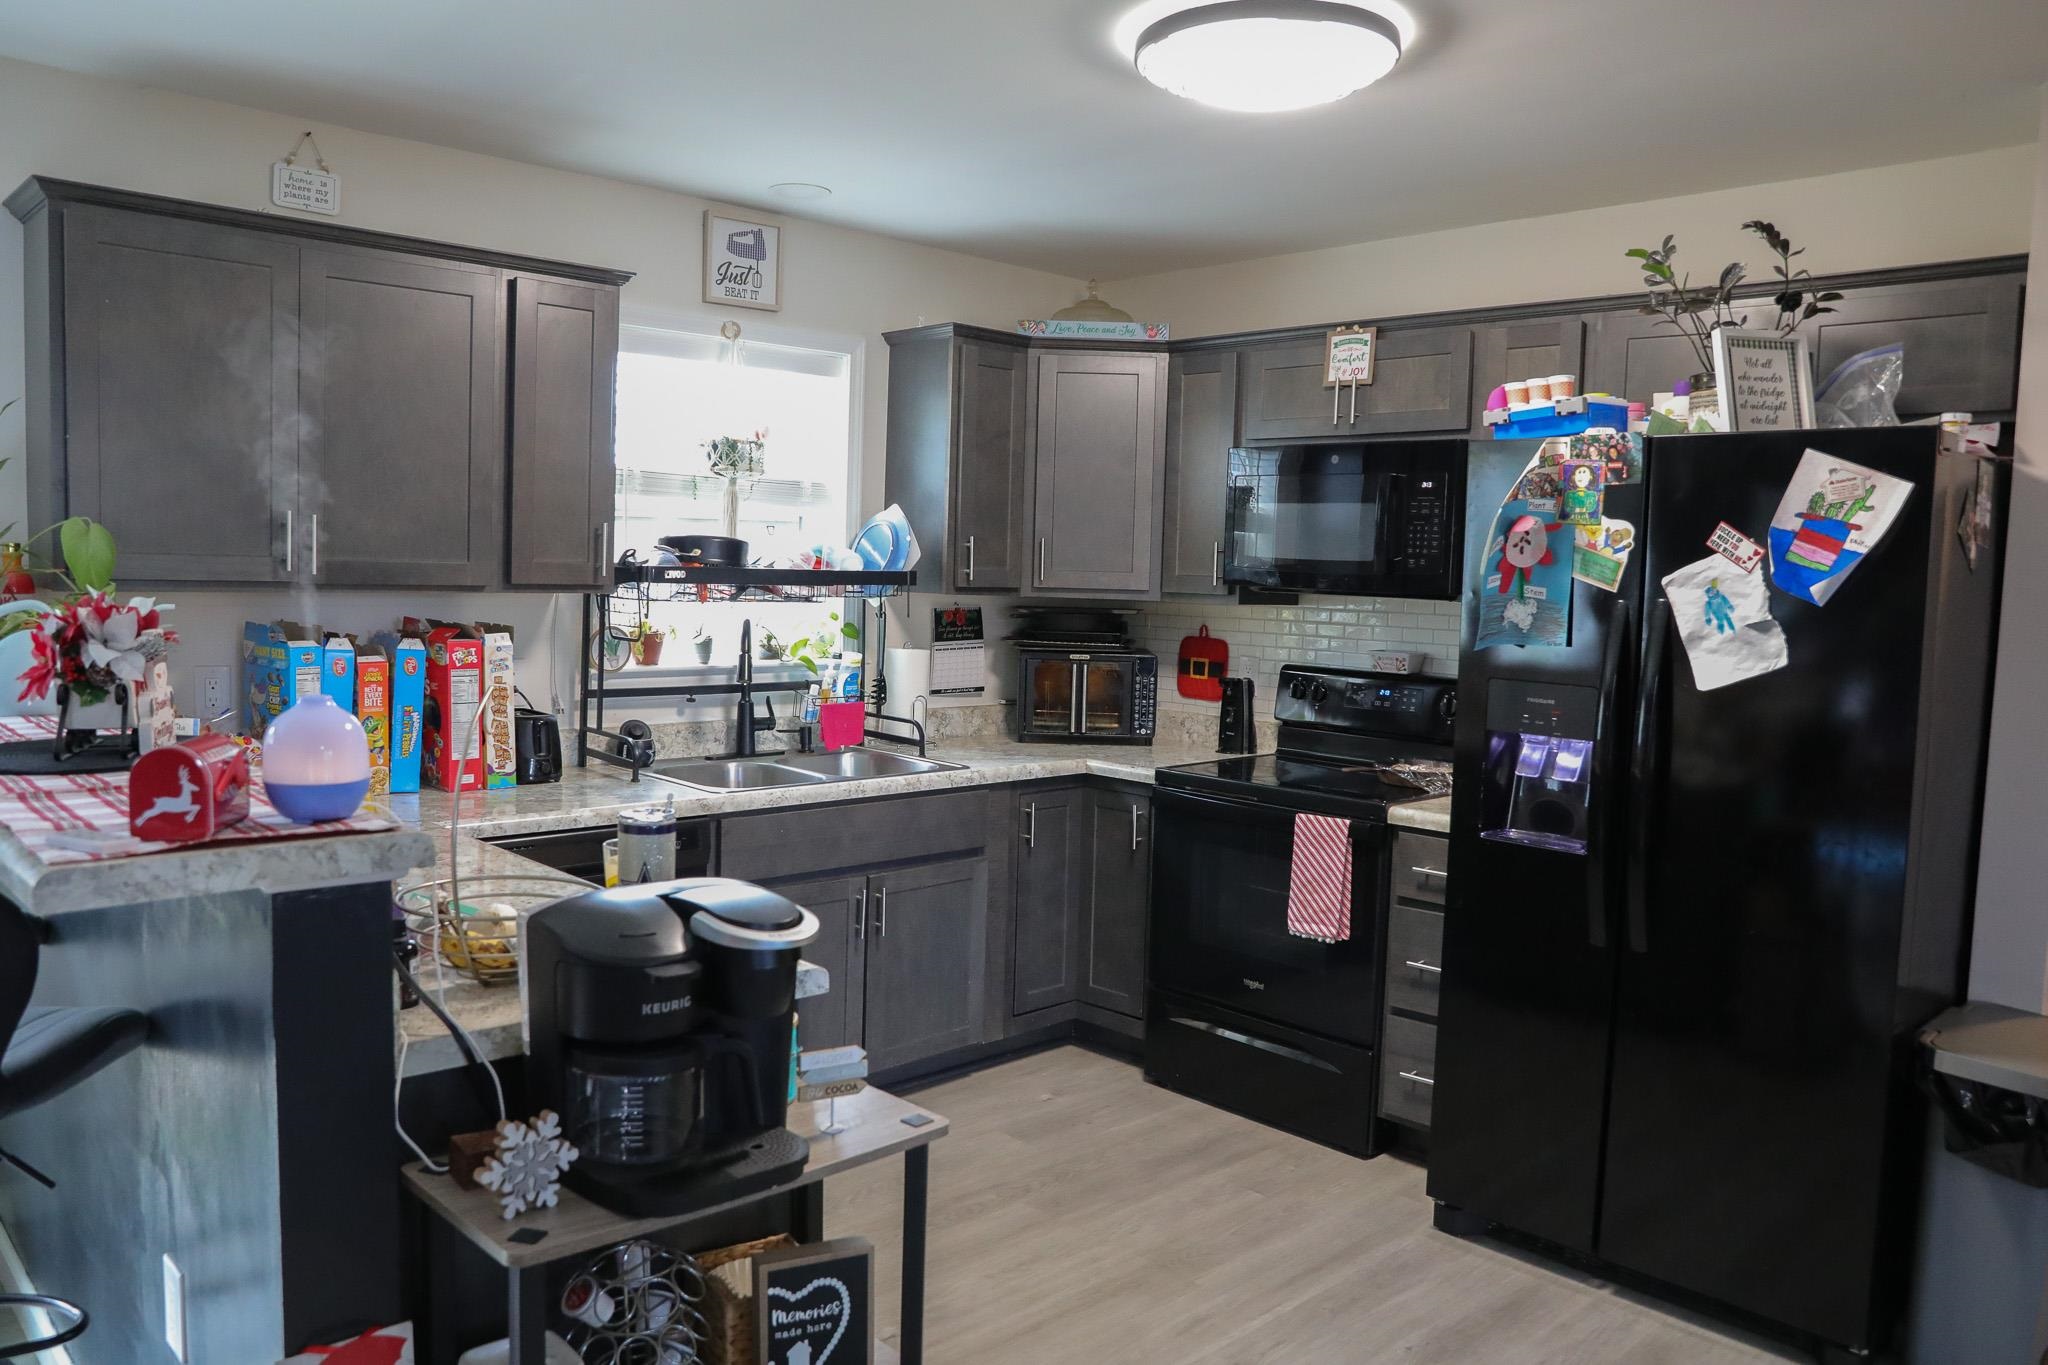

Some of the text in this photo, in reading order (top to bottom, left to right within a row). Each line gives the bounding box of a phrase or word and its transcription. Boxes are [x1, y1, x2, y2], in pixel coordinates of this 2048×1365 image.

[288, 172, 315, 186] home
[283, 191, 311, 201] plants
[284, 183, 329, 197] where my
[715, 261, 756, 285] Just
[724, 286, 760, 300] BEAT IT
[1077, 323, 1099, 334] Peace
[1118, 325, 1137, 337] Joy
[1332, 352, 1369, 366] Comfort
[1761, 359, 1773, 369] all
[1348, 367, 1366, 377] JOY
[1737, 371, 1783, 383] who wander
[1738, 384, 1785, 400] to the fridge
[1740, 399, 1787, 415] at midnight
[1750, 414, 1779, 425] are lost
[1528, 501, 1546, 509] Plant
[1717, 533, 1730, 546] NEED
[1721, 546, 1736, 559] WITH
[1525, 588, 1545, 597] Stem
[364, 692, 383, 700] EVERY
[364, 698, 383, 707] BITE
[641, 995, 692, 1015] KEURIG
[825, 1083, 859, 1096] COCOA
[771, 1300, 842, 1327] Memories
[774, 1322, 833, 1339] made here
